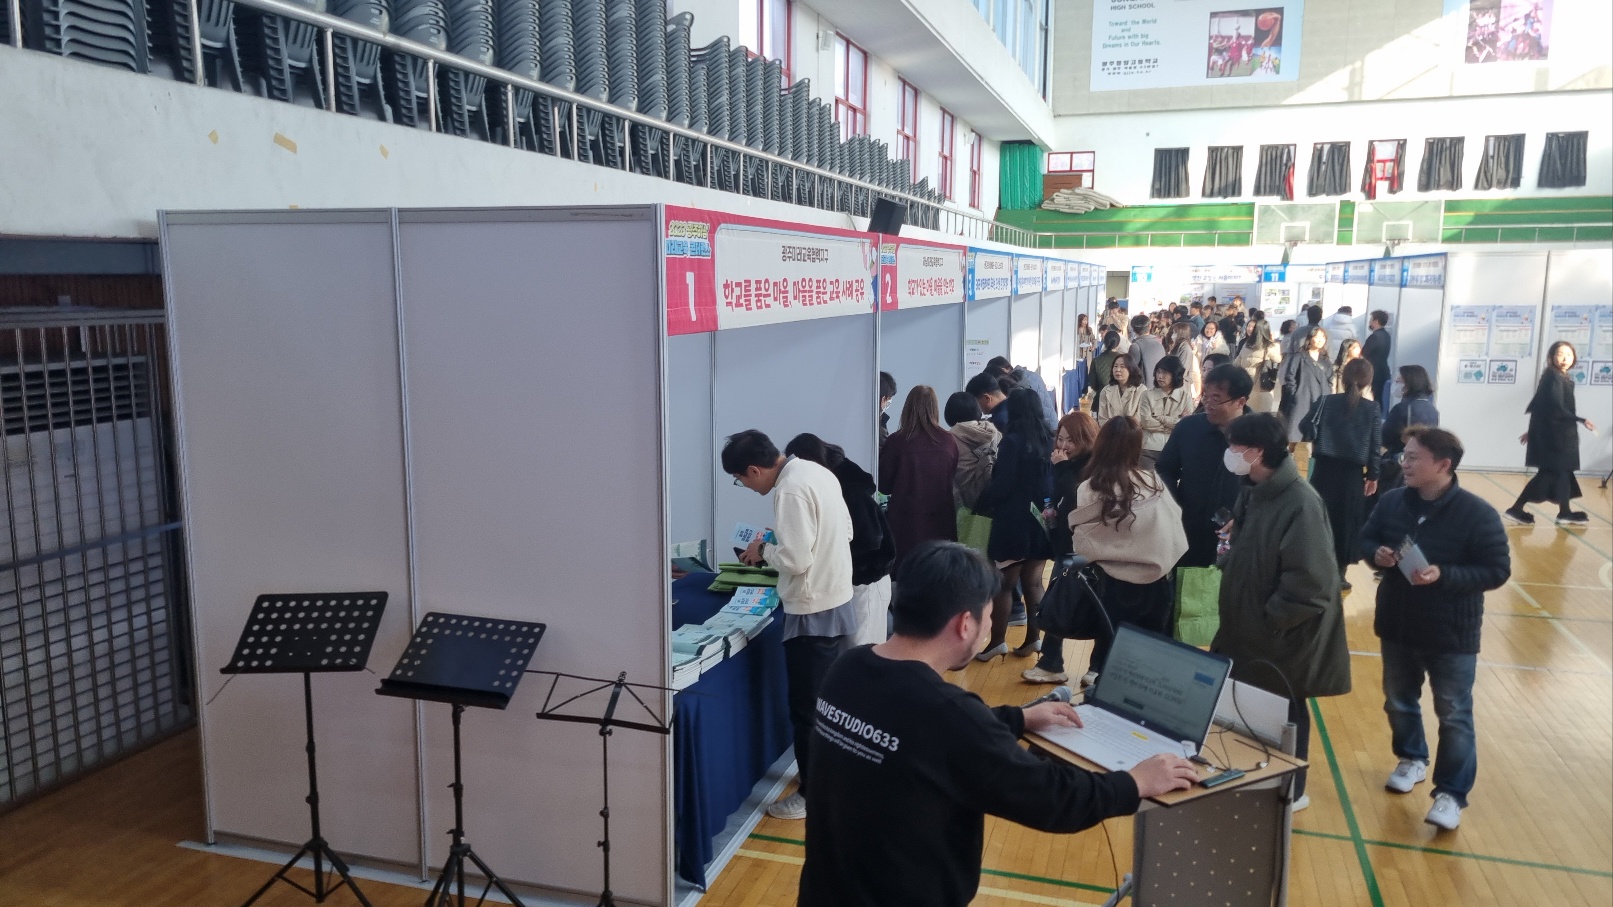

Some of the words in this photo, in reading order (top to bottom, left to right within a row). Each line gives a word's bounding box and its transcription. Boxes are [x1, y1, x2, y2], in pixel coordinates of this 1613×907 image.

[781, 245, 829, 264] 광주미래교육협력지구
[885, 272, 893, 304] 2
[1270, 272, 1279, 282] 11
[685, 271, 697, 322] 1
[722, 278, 753, 312] 학교를
[754, 277, 772, 311] 품은
[772, 277, 792, 309] 마을,
[792, 277, 815, 308] 마을을
[815, 277, 829, 306] 품은
[829, 278, 842, 304] 교육
[841, 279, 854, 301] 사례
[854, 278, 865, 304] 공유
[816, 696, 900, 752] WAVESTUDIO633
